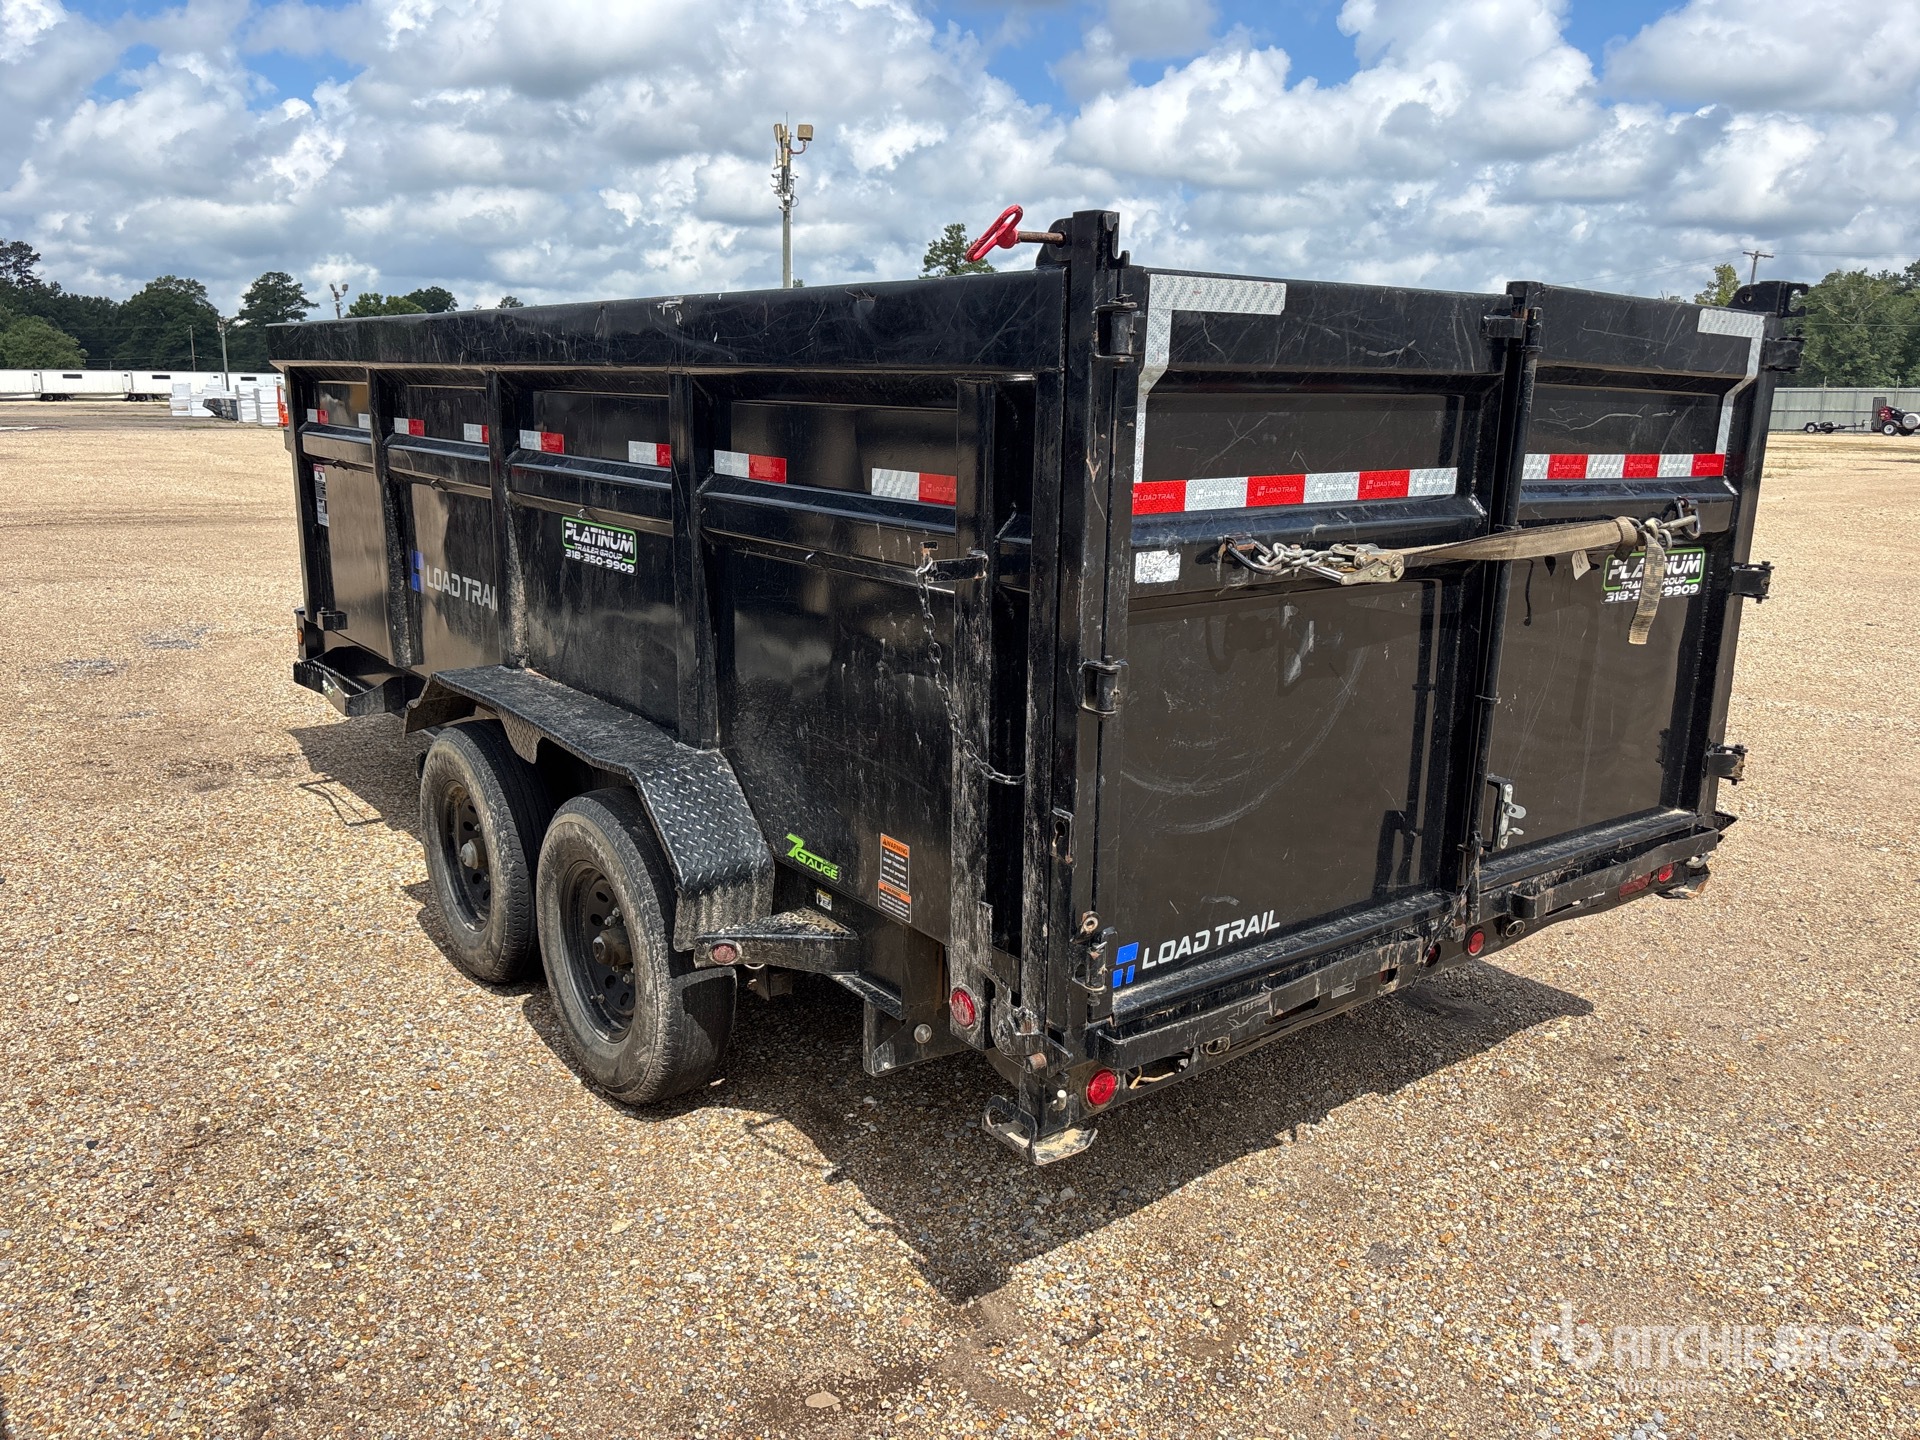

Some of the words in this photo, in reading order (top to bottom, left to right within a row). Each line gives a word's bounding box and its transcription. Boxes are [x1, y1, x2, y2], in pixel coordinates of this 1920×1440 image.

[565, 521, 634, 554] PLATINUM
[565, 548, 635, 574] 318-350-9909
[573, 542, 599, 556] TRAILER
[599, 549, 623, 560] GROUP
[1607, 553, 1702, 580] PLANUM
[426, 564, 461, 598] LOAD
[1604, 583, 1699, 602] 318-3-9909
[1662, 576, 1686, 585] ROUP
[786, 832, 804, 858] 7
[795, 848, 839, 880] GAUGE
[886, 840, 908, 855] WARNING
[1142, 929, 1211, 970] LOAD
[1214, 909, 1281, 946] TRAIL
